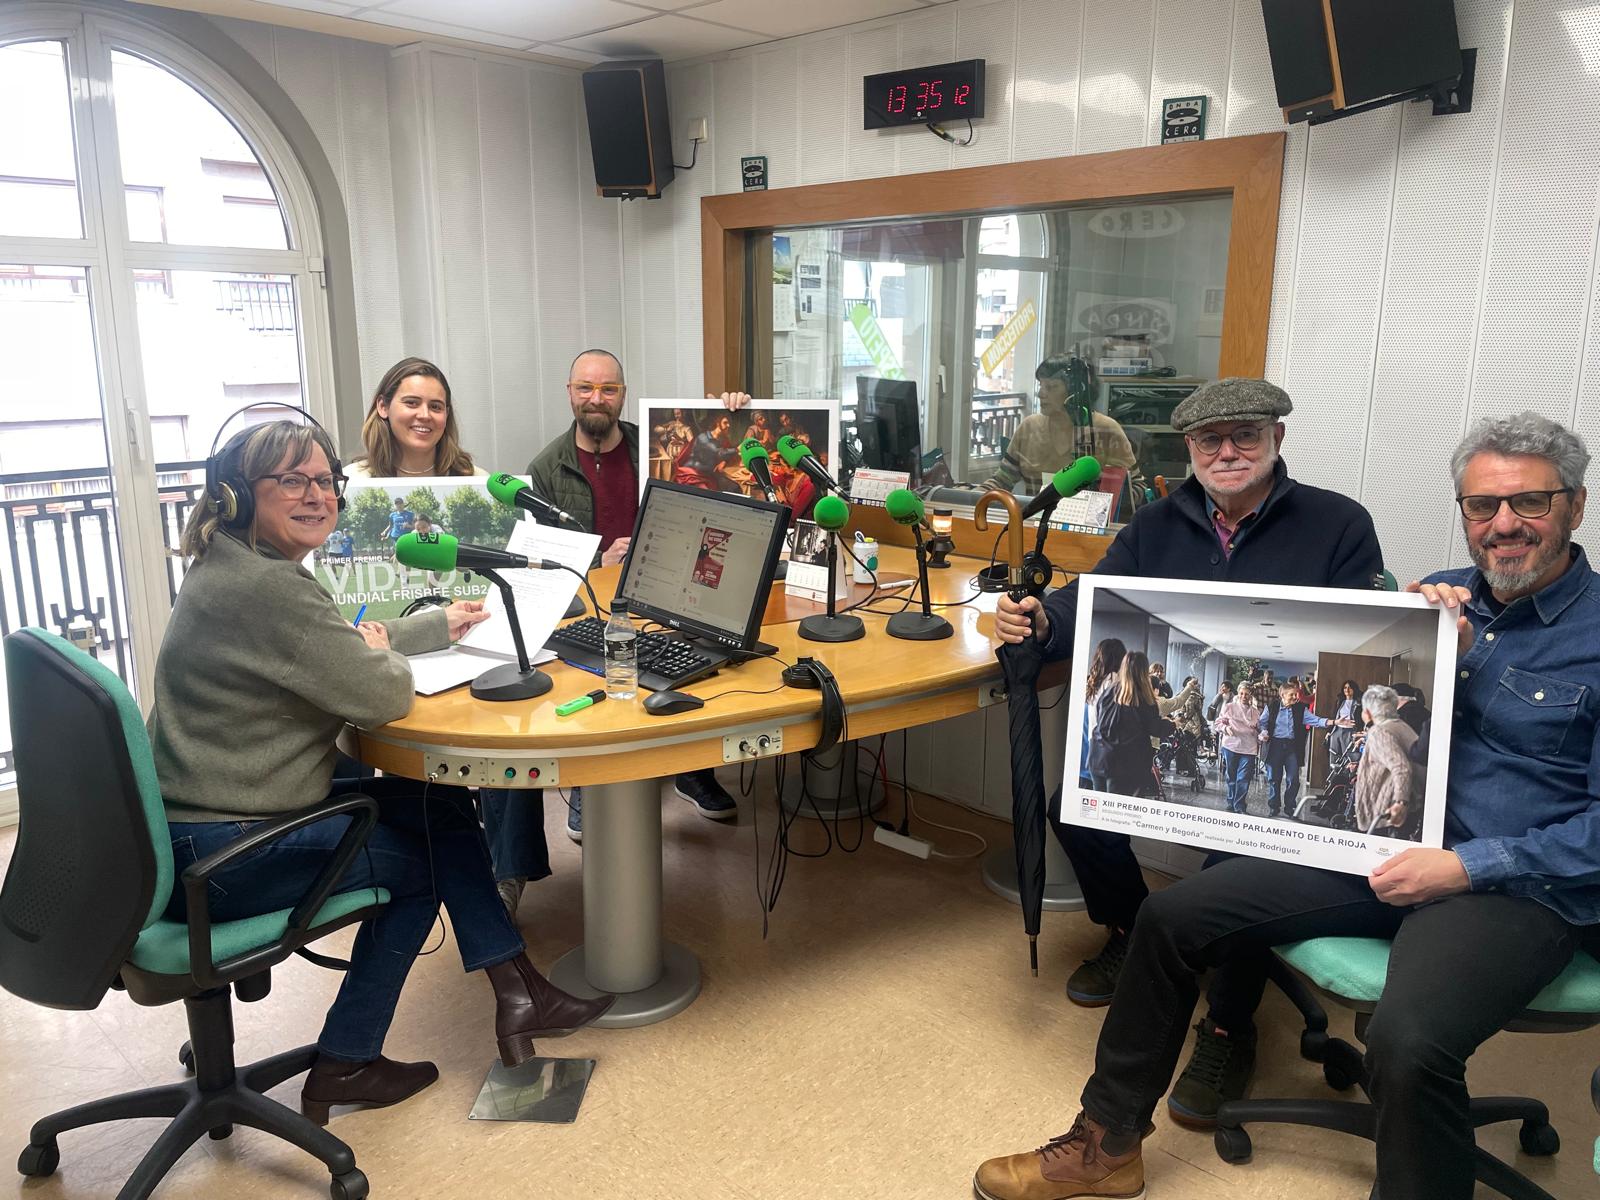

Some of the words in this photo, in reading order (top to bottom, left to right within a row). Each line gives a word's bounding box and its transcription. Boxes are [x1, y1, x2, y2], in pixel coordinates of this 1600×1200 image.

[887, 86, 907, 113] 13
[916, 80, 942, 110] 35
[954, 85, 970, 105] 12
[1168, 101, 1199, 110] ONDA
[1165, 125, 1197, 136] CERO
[321, 557, 352, 565] PRIMER
[353, 555, 383, 563] PREMIO
[392, 586, 450, 601] FRISBEE
[1102, 800, 1116, 809] XIII
[1117, 802, 1148, 814] PREMIO
[1150, 807, 1162, 816] DE
[1164, 809, 1240, 829] FOTOPERIODISMO
[1242, 823, 1305, 839] PARLAMENTO
[1307, 833, 1320, 842] DE
[1323, 836, 1335, 845] LA
[1337, 838, 1367, 850] RIOJA
[1235, 837, 1258, 848] Justo
